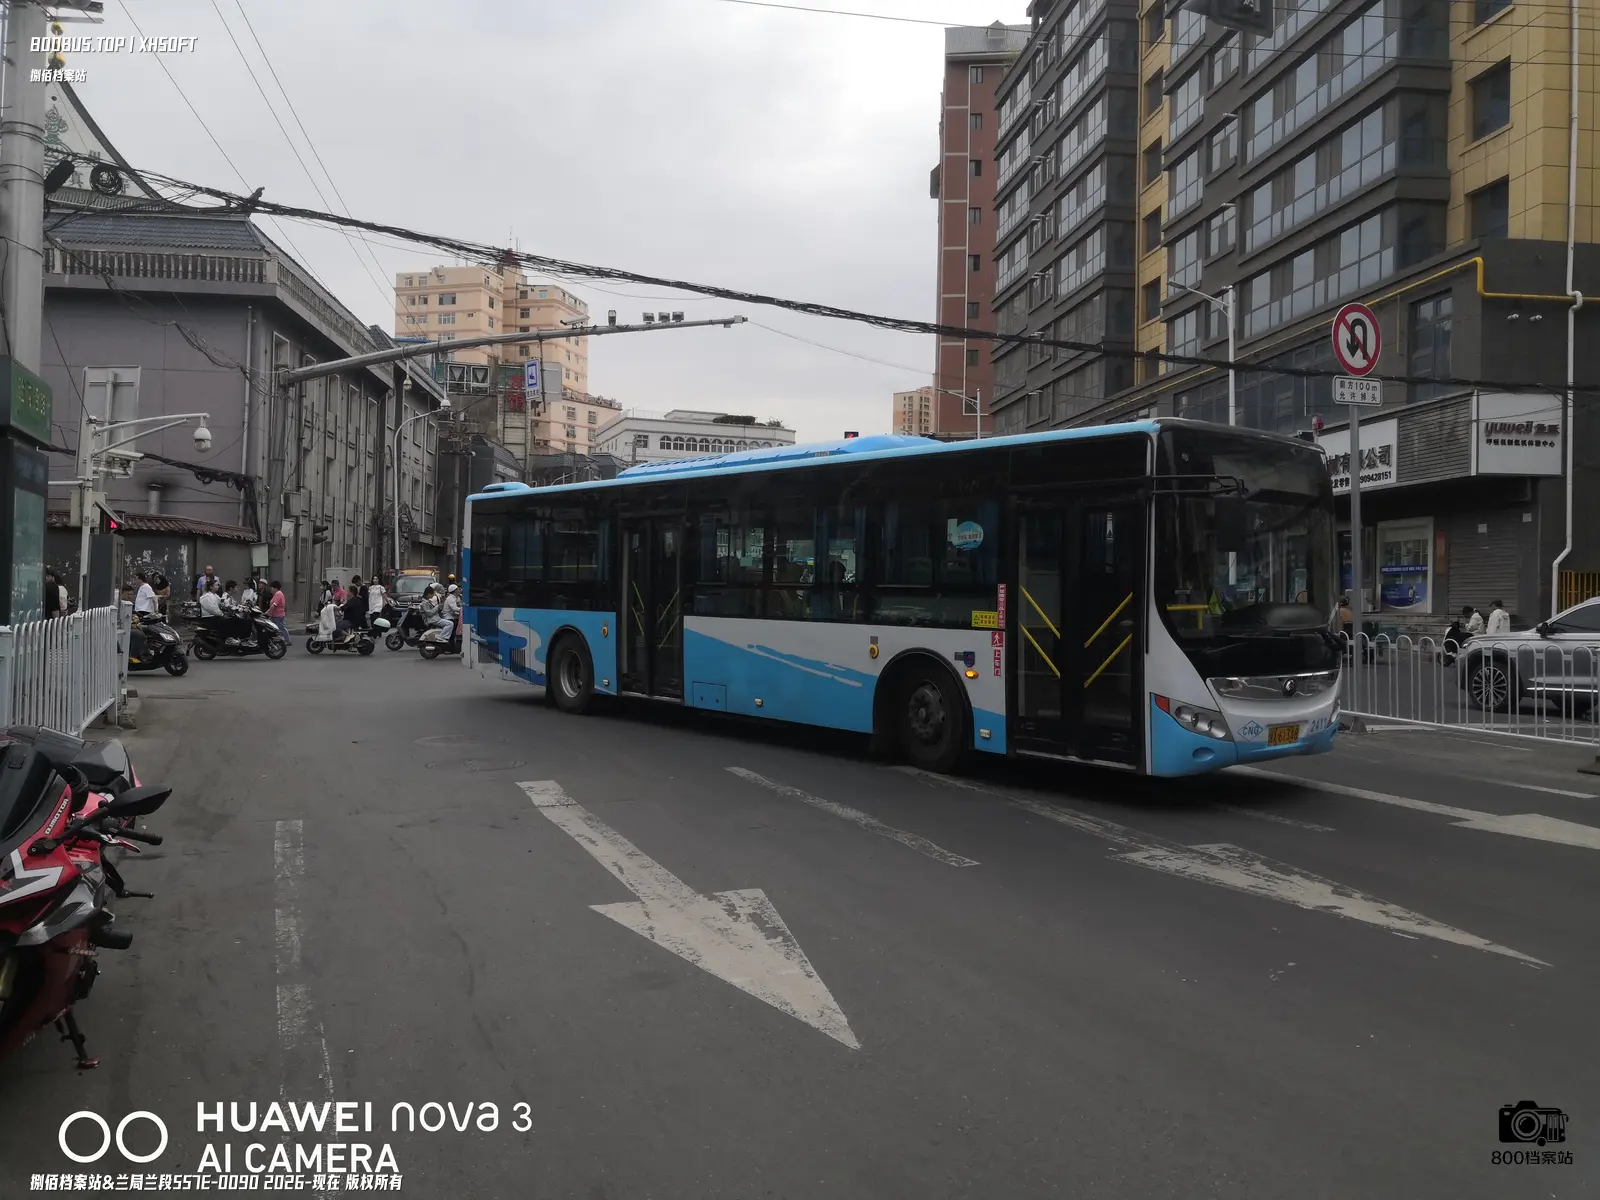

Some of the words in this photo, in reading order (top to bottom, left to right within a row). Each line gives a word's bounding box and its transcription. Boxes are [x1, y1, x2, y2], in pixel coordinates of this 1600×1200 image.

[1339, 380, 1378, 391] 前方100m
[1339, 390, 1378, 402] 允许掉头
[1242, 726, 1259, 736] CNG
